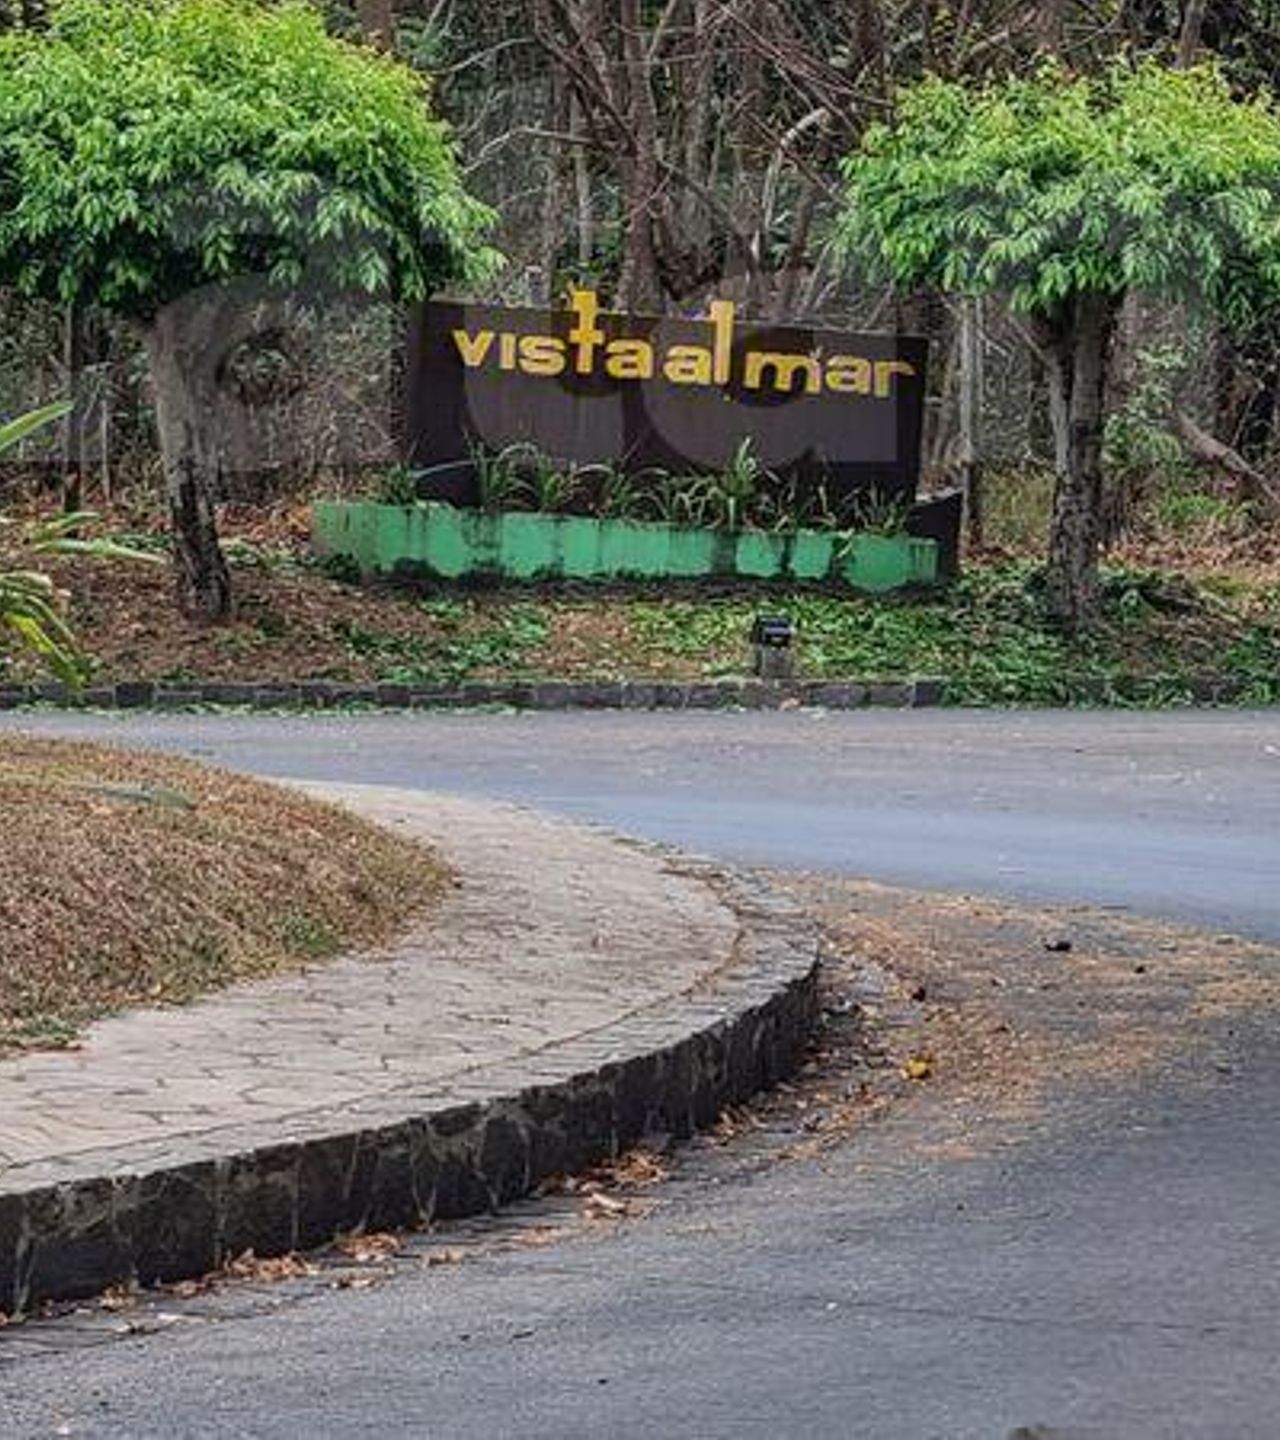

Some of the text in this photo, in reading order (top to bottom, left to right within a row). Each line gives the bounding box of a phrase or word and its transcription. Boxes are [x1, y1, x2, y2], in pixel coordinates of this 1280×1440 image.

[453, 288, 916, 398] vista al mar
